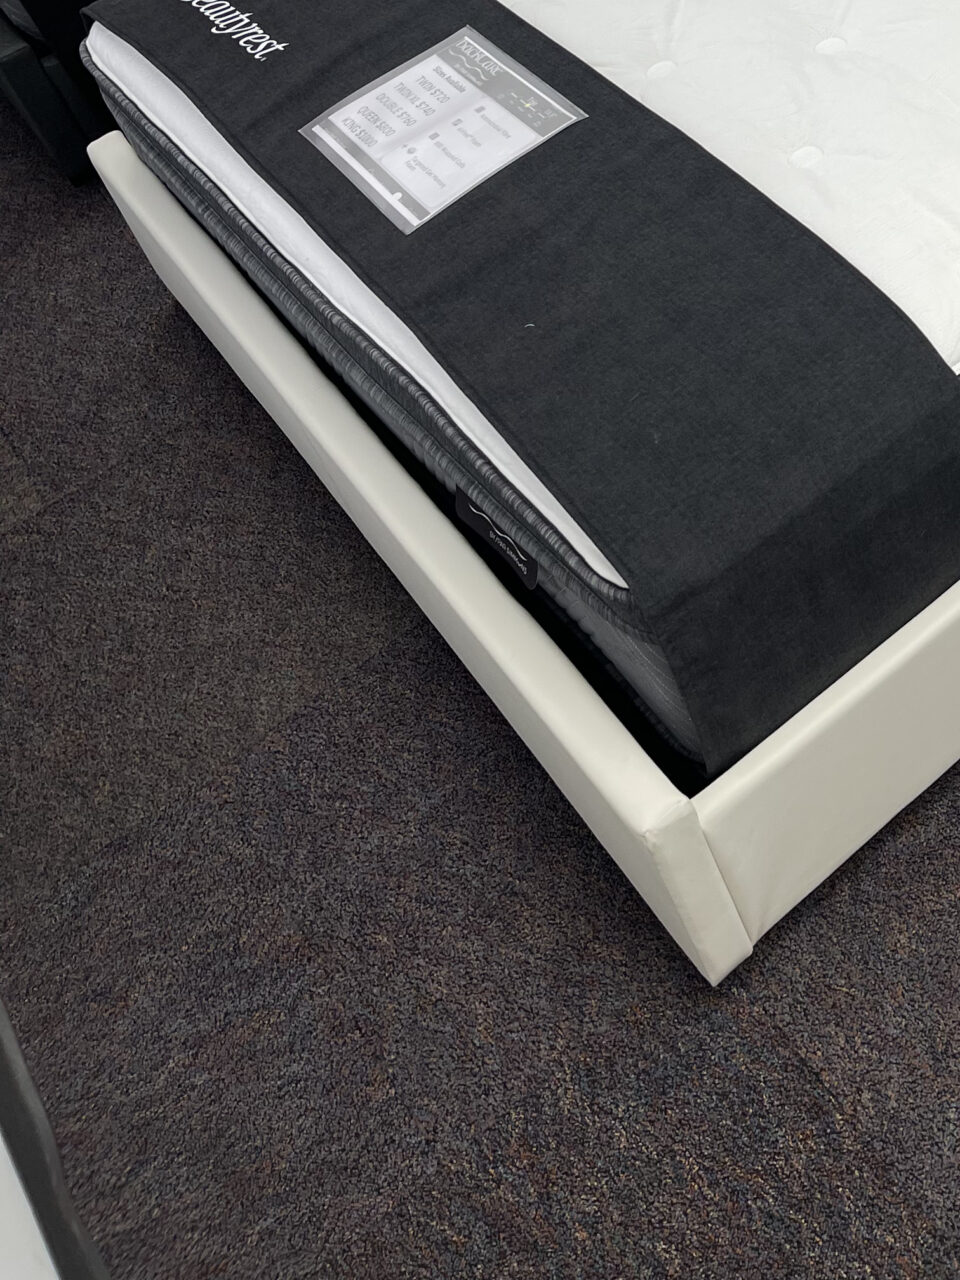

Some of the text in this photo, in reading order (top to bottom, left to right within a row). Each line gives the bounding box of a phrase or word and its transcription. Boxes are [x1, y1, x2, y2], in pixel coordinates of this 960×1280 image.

[414, 76, 450, 103] TWIN $720
[356, 105, 382, 125] QUEEN
[375, 93, 417, 126] DOUBLE $760
[415, 101, 436, 116] $740
[341, 117, 360, 132] KING
